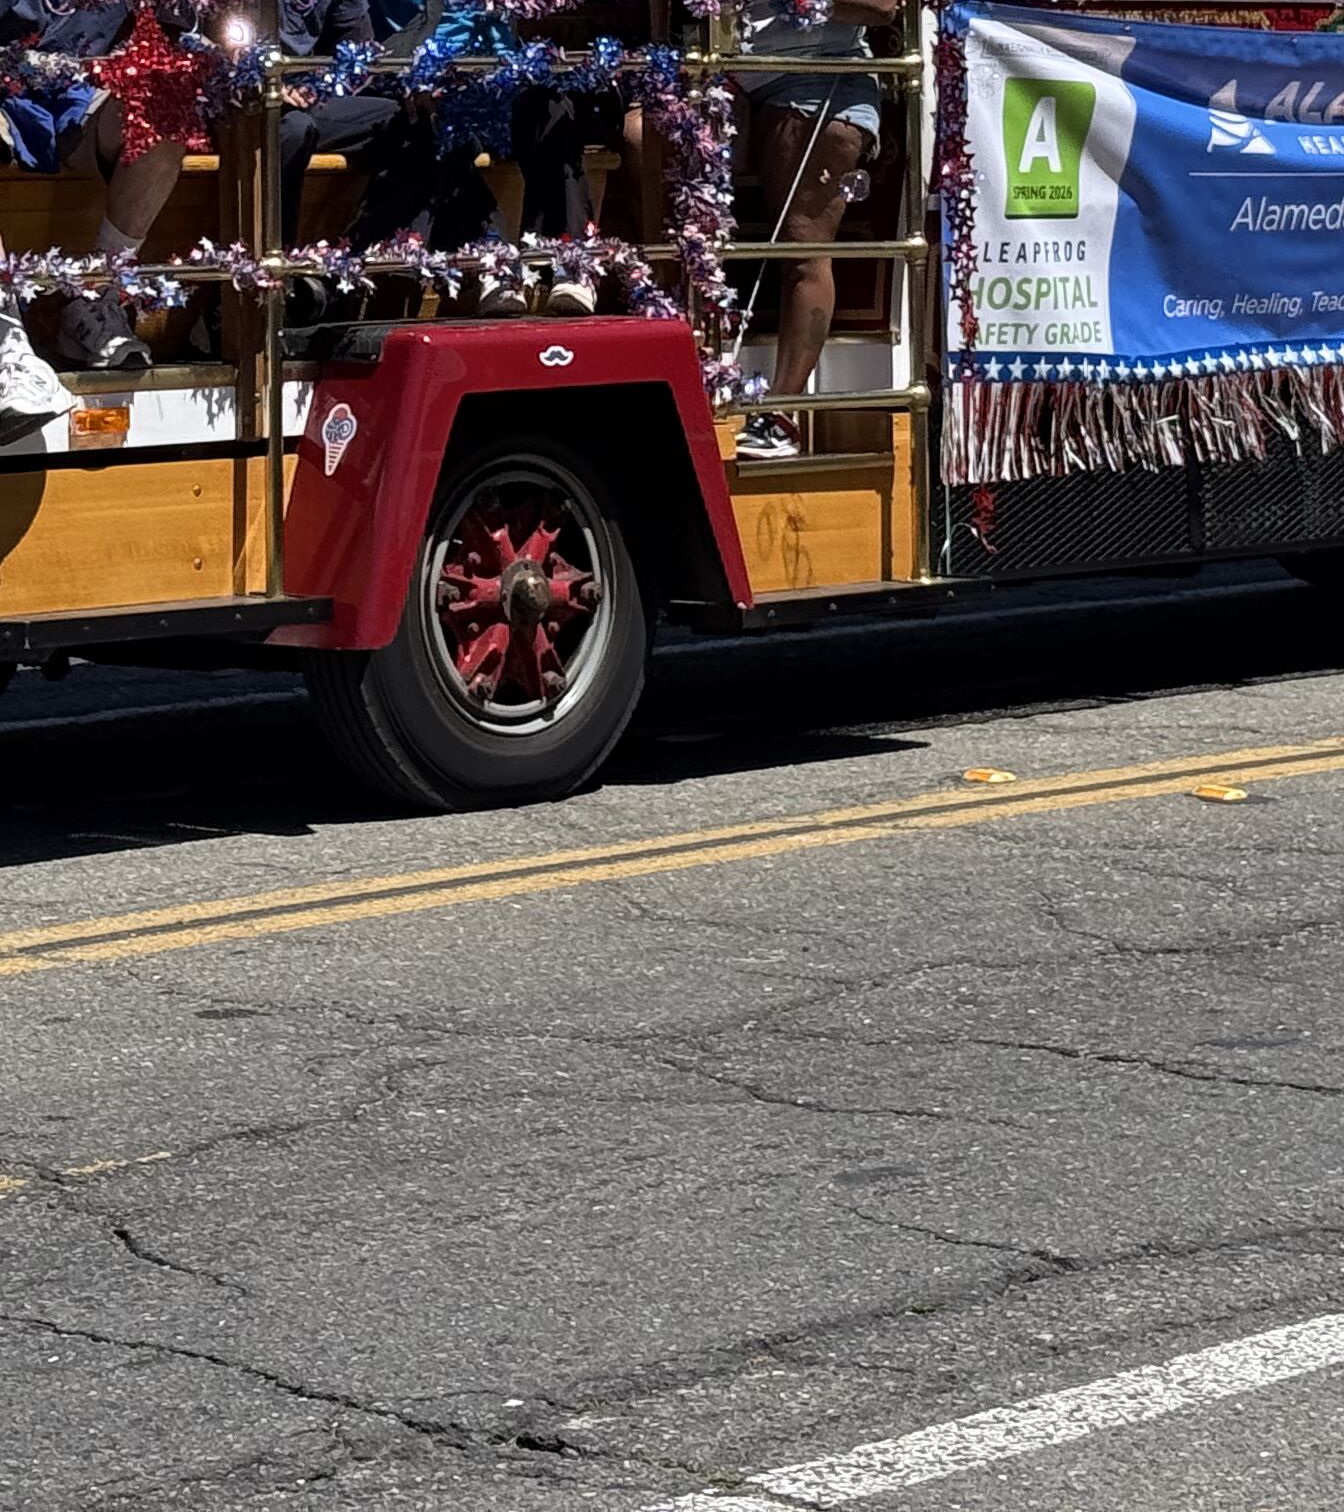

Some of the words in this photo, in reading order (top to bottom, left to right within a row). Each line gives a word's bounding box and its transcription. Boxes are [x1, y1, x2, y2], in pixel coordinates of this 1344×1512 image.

[1018, 95, 1063, 174] A
[1049, 185, 1073, 200] 2026
[983, 240, 1086, 264] LEAPFROG
[972, 275, 1098, 311] HOSPITAL
[1163, 294, 1224, 319] Caring,
[1232, 292, 1303, 317] Healing,
[973, 322, 1039, 345] AFETY
[1044, 321, 1102, 345] GRADE
